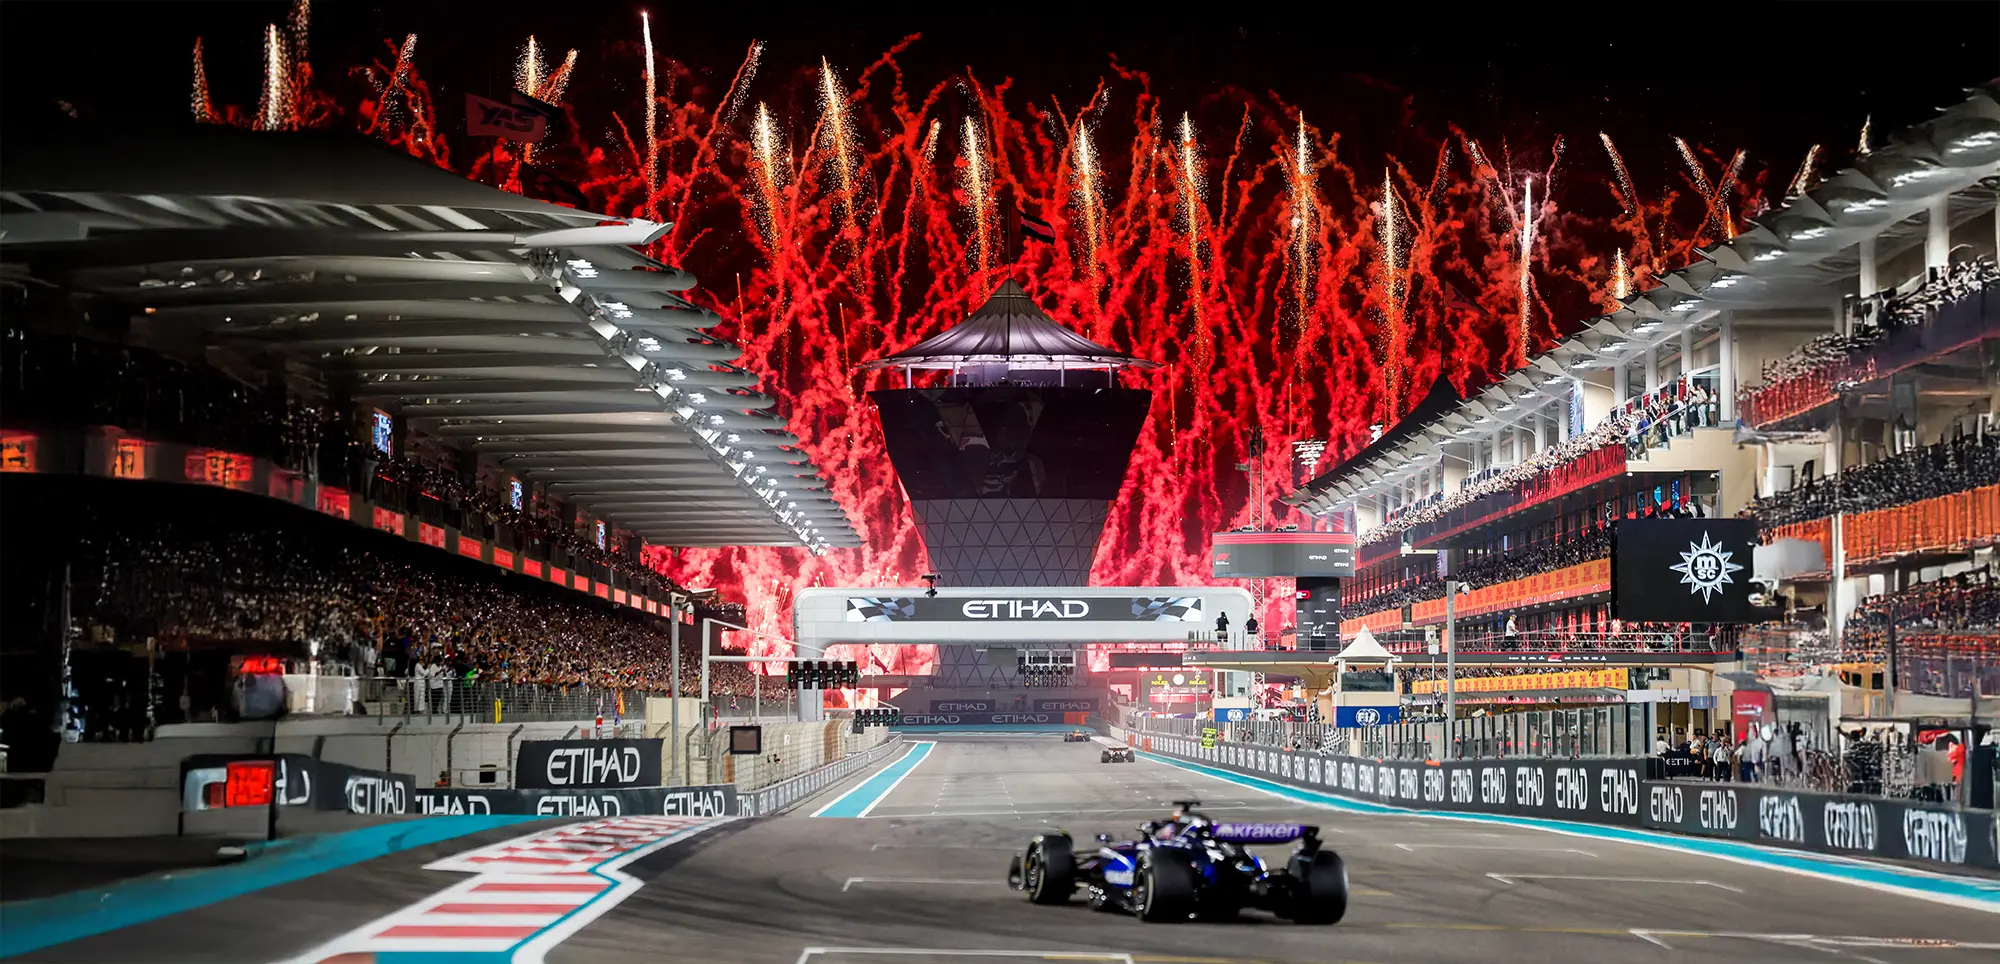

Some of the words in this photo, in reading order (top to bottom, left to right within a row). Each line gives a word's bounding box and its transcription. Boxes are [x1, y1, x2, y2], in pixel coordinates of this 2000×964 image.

[478, 102, 540, 133] YAS
[962, 600, 1090, 619] ETIHAD
[903, 715, 960, 724] ETIHAD
[938, 703, 988, 711] ETIHAD
[992, 714, 1049, 723] ETIHAD
[1042, 702, 1091, 710] ETIHAD
[1358, 711, 1379, 723] FIA
[547, 747, 641, 786] ETIHAD
[352, 777, 406, 814] ETIHAD
[1451, 768, 1473, 803] ETIHAD
[1481, 767, 1507, 804] ETIHAD
[1516, 767, 1544, 806] ETIHAD
[1556, 767, 1588, 810] ETIHAD
[1601, 768, 1638, 815] ETIHAD
[537, 795, 621, 816] ETIHAD
[664, 791, 726, 817] ETIHAD
[1651, 786, 1683, 824] ETIHAD
[1700, 789, 1738, 829] ETIHAD
[1235, 823, 1301, 839] kraken
